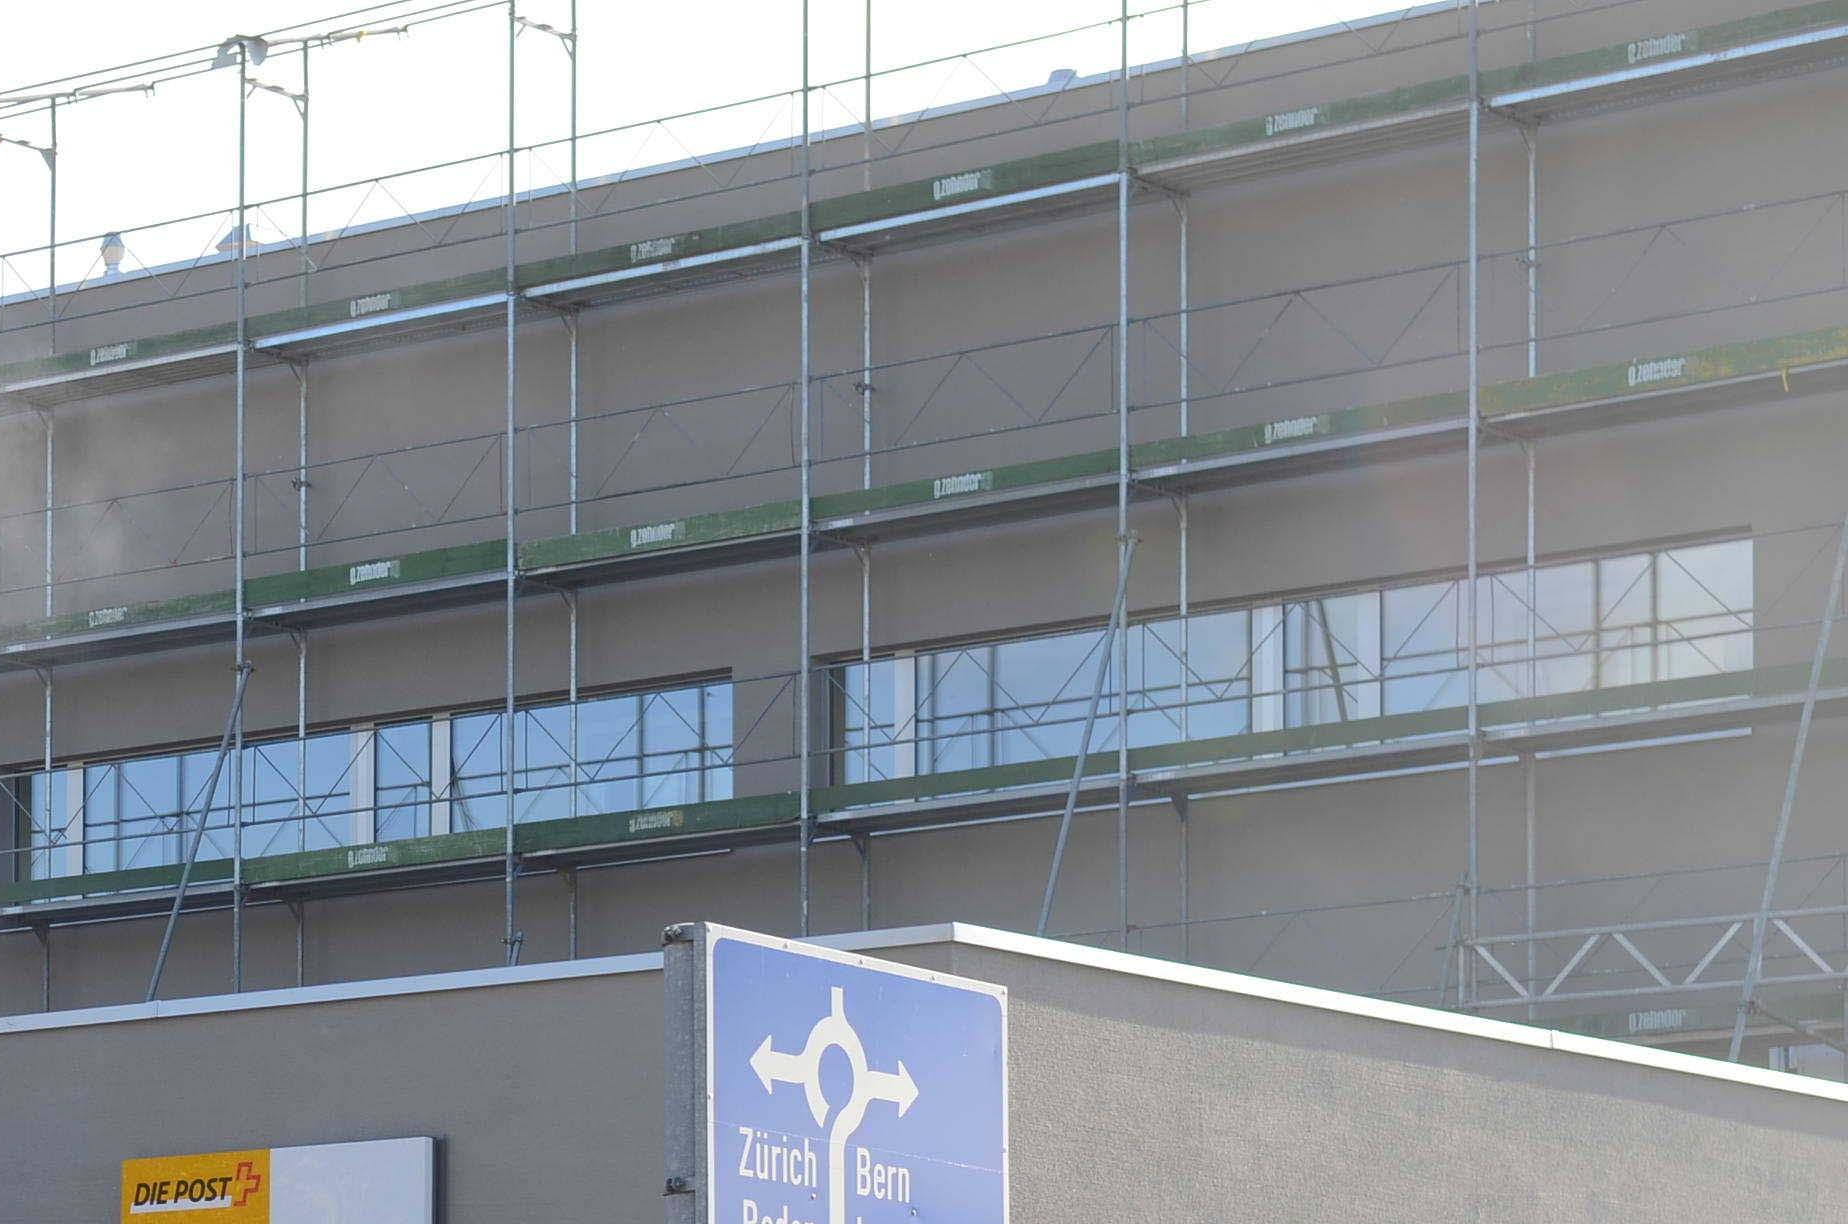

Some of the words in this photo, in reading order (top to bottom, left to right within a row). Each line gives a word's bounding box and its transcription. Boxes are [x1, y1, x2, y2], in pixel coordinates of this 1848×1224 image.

[738, 1127, 817, 1188] Zürich
[856, 1146, 911, 1204] Bern
[133, 1181, 169, 1206] DIE
[173, 1176, 233, 1204] POST
